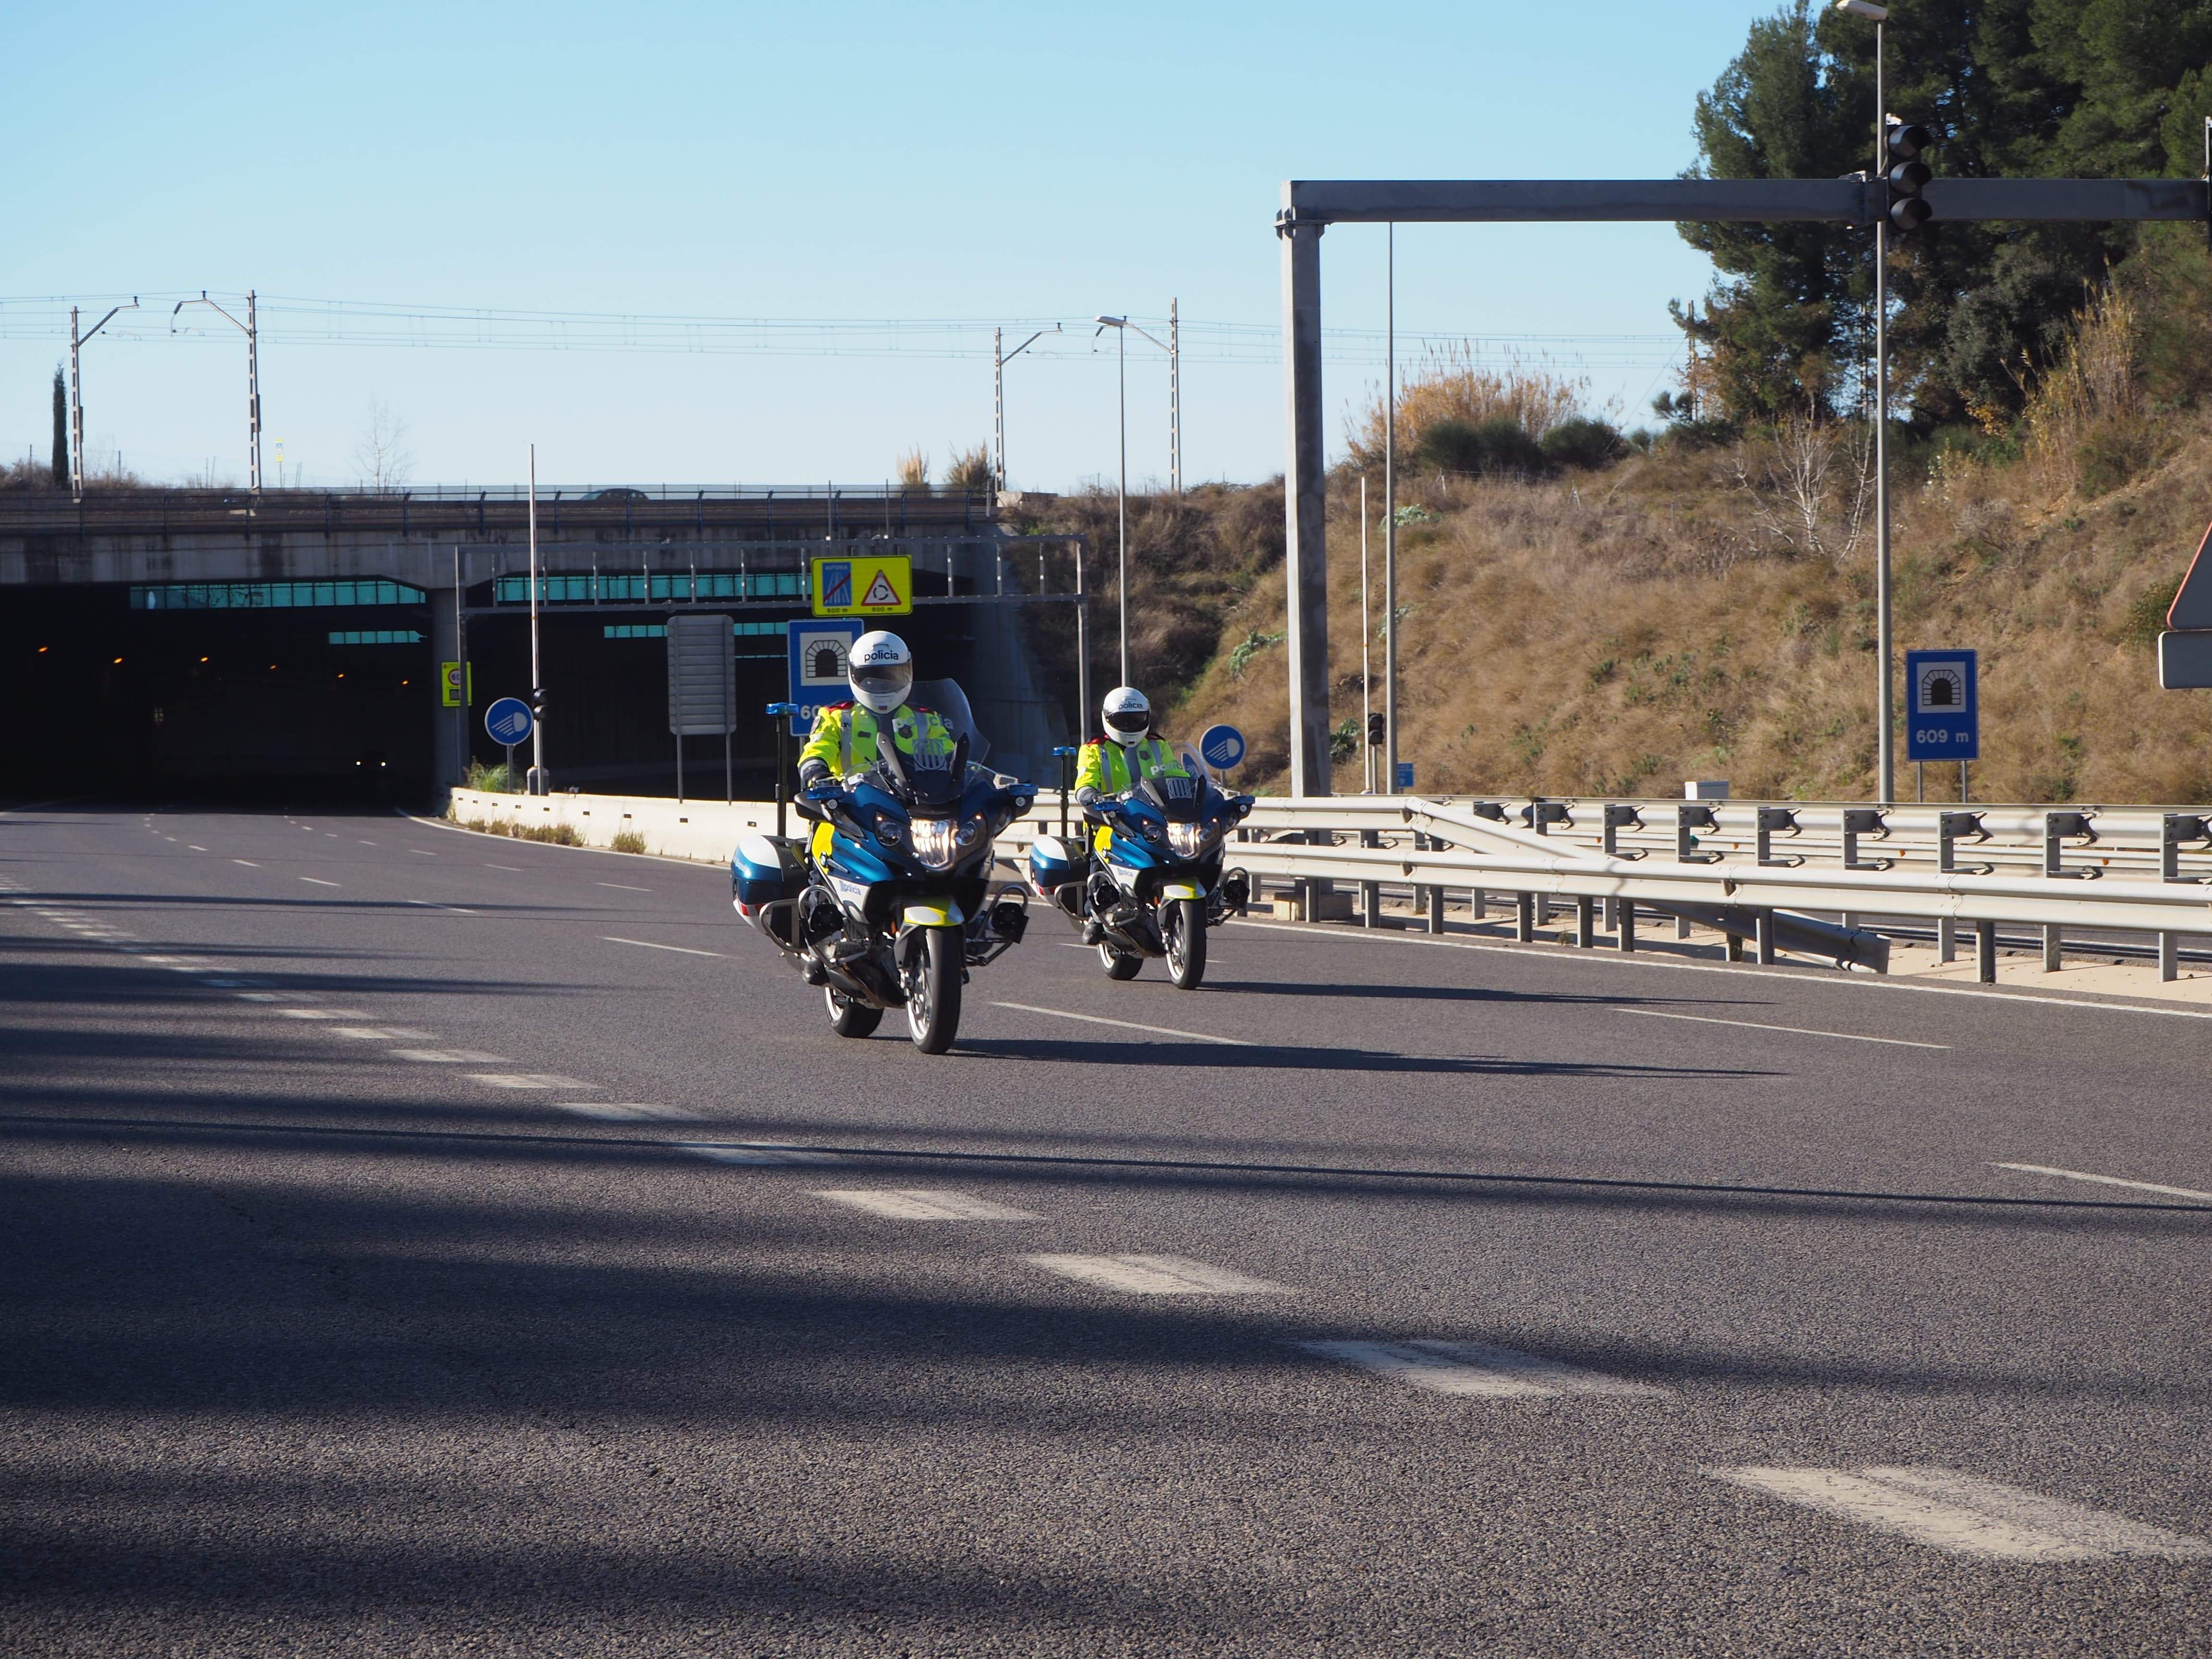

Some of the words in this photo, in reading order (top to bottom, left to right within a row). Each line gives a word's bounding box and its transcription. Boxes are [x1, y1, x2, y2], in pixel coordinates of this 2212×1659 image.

[865, 650, 899, 662] policia
[1118, 701, 1142, 709] policia
[1916, 730, 1948, 744] 609
[1956, 732, 1969, 742] m
